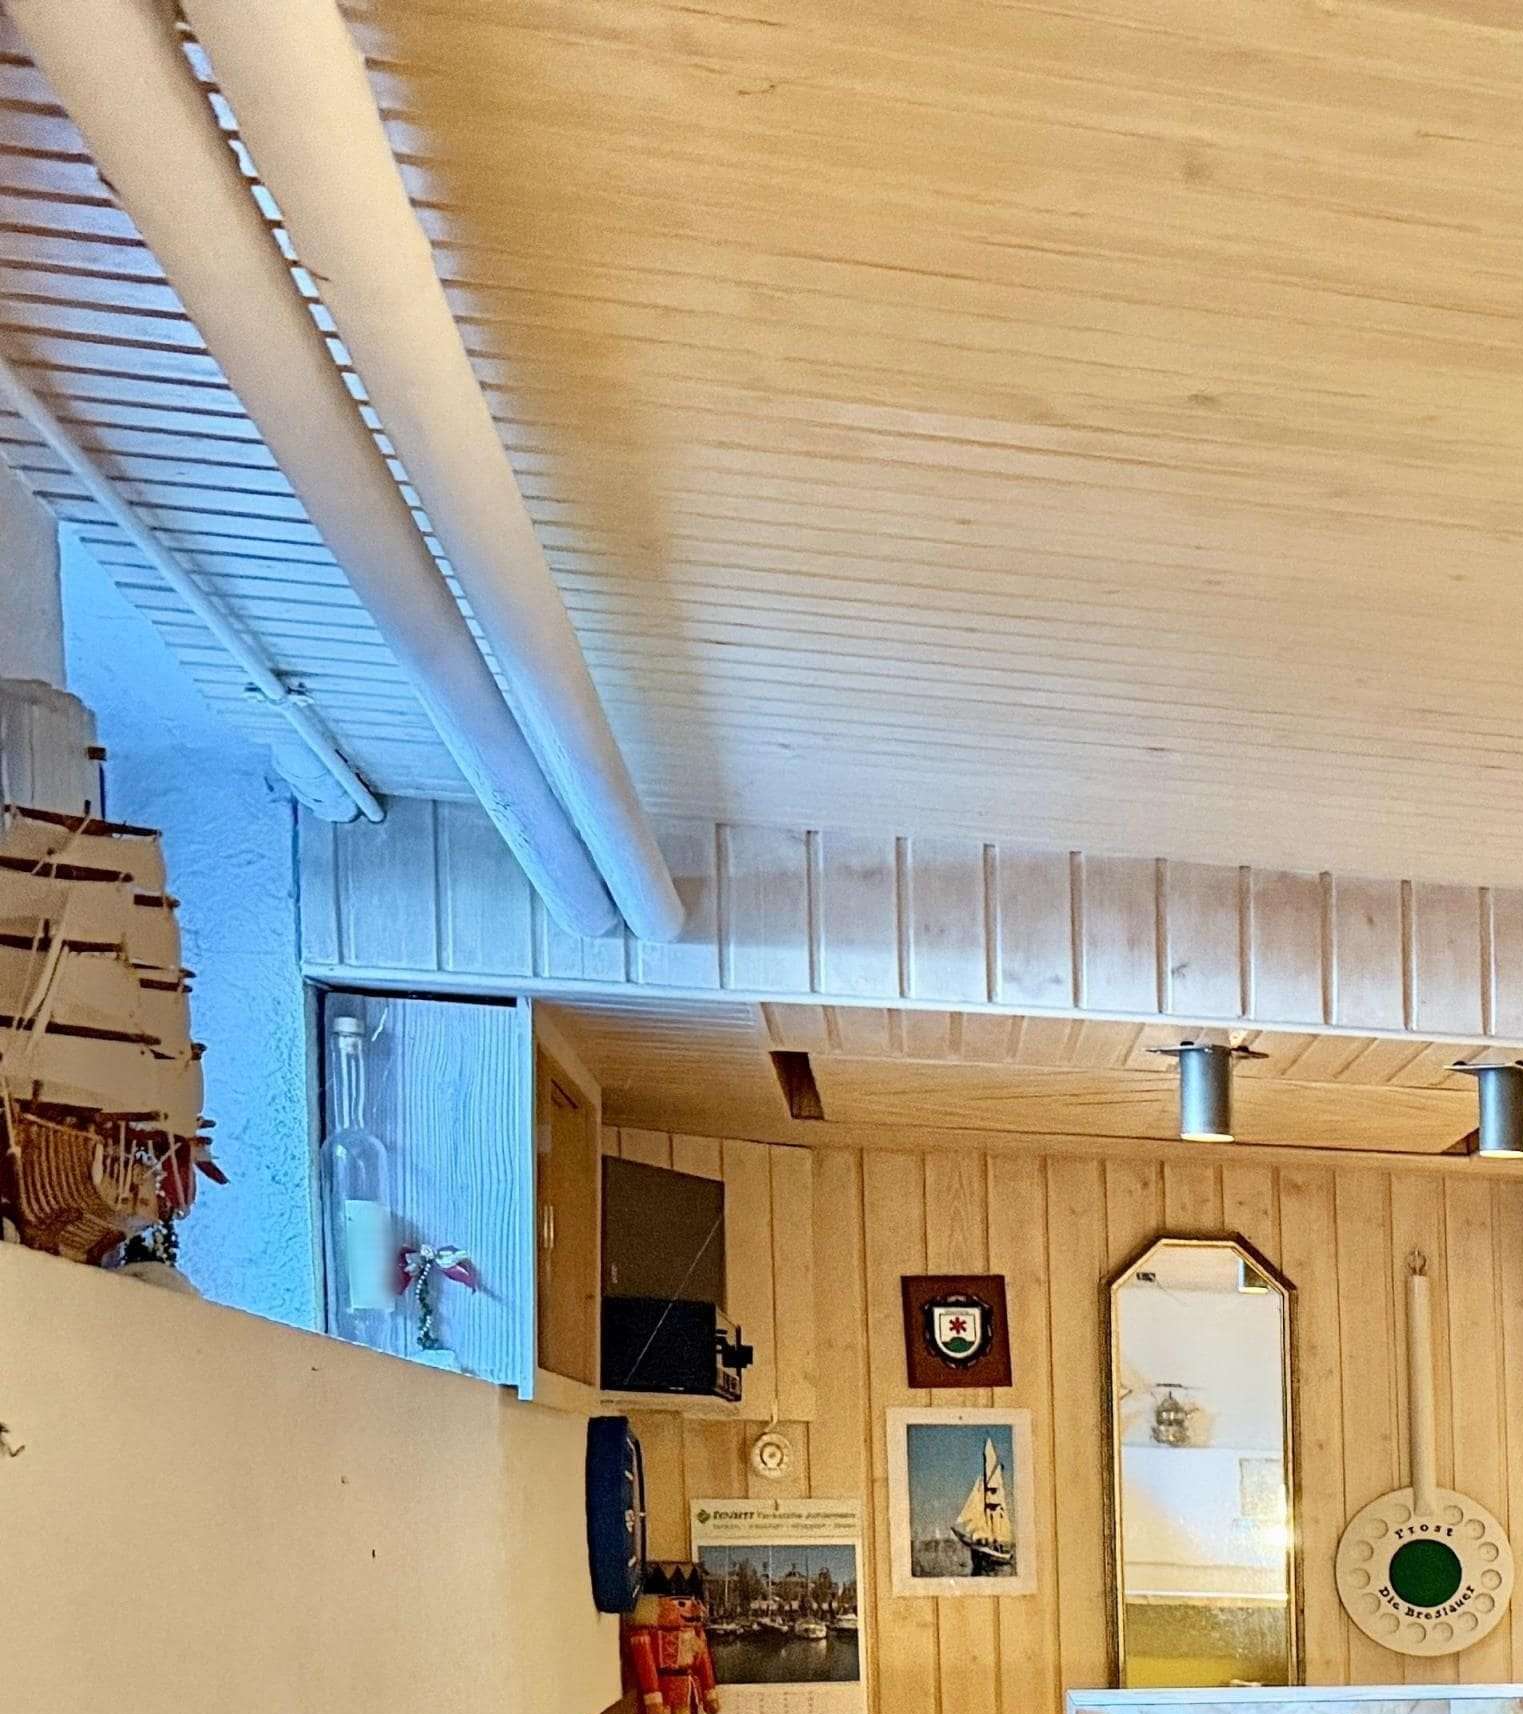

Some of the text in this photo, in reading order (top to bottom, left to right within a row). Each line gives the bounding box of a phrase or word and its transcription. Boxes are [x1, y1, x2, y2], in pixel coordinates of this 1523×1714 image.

[1394, 1524, 1453, 1539] Prost
[1379, 1585, 1475, 1620] Die Breslauer
